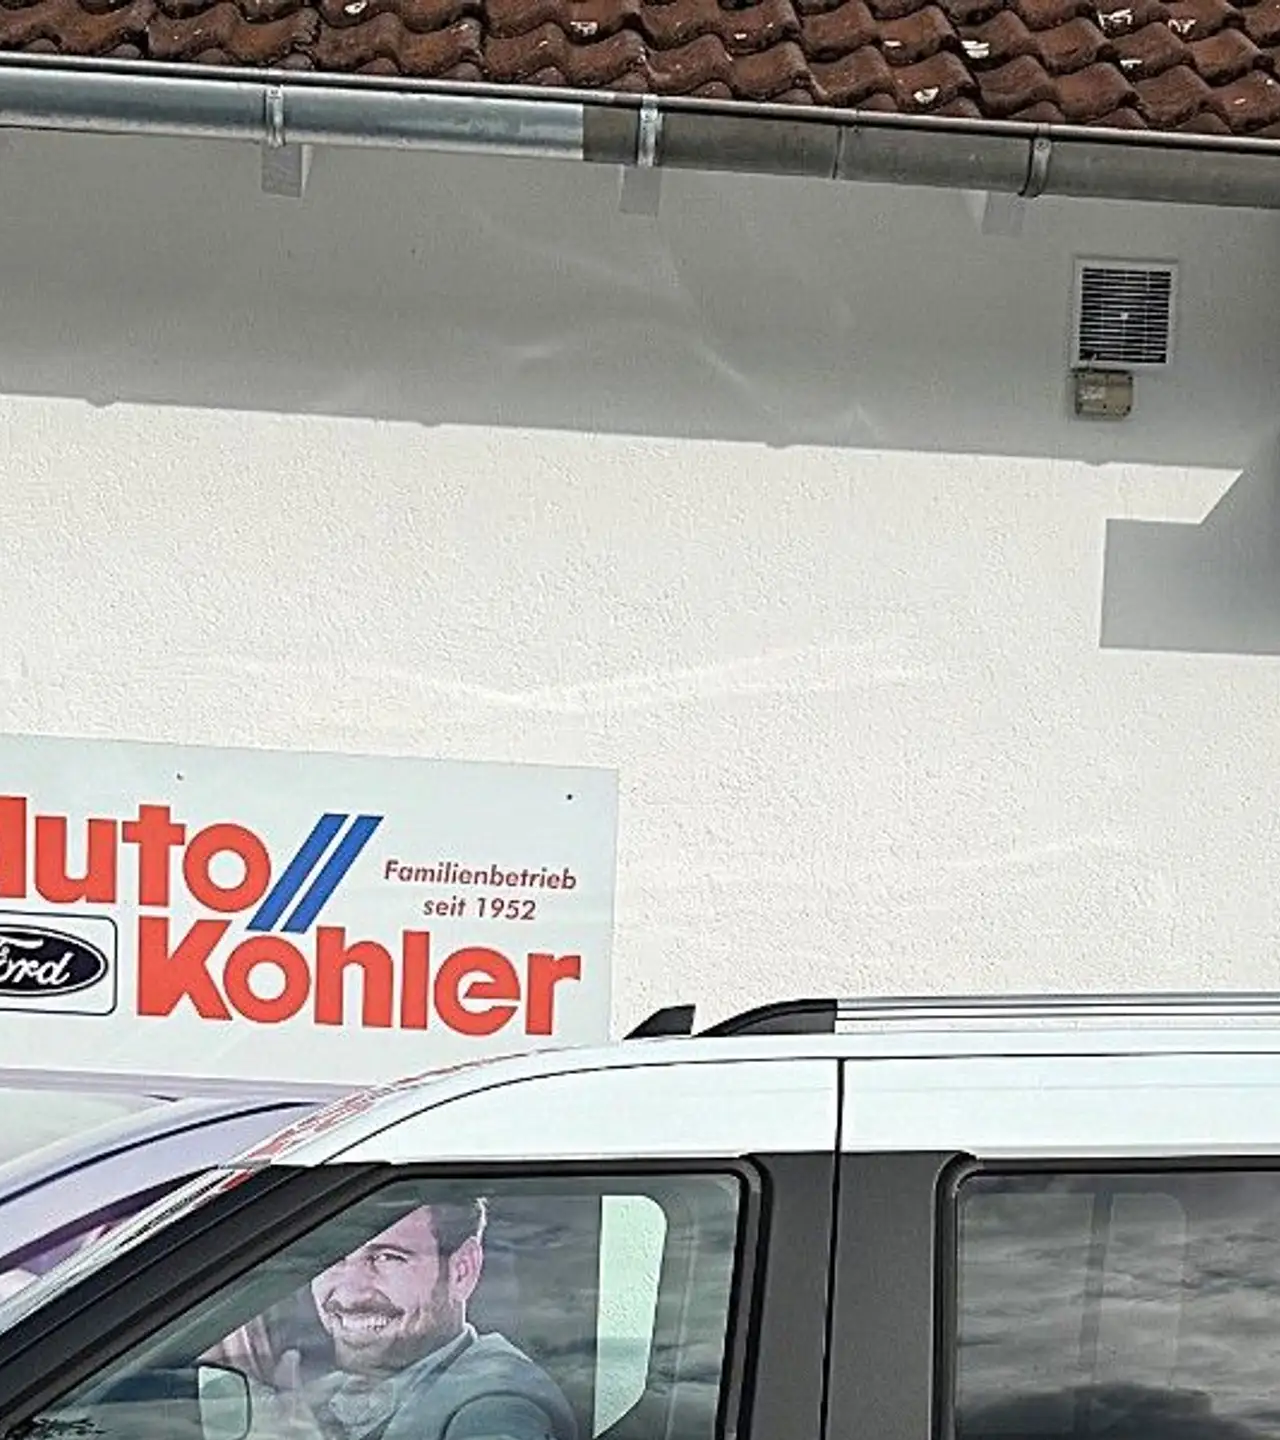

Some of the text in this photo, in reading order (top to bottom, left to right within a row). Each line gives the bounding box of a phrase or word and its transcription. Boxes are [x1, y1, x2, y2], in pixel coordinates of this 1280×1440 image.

[383, 859, 577, 890] Familienbetrieb
[423, 894, 536, 921] seit 1952
